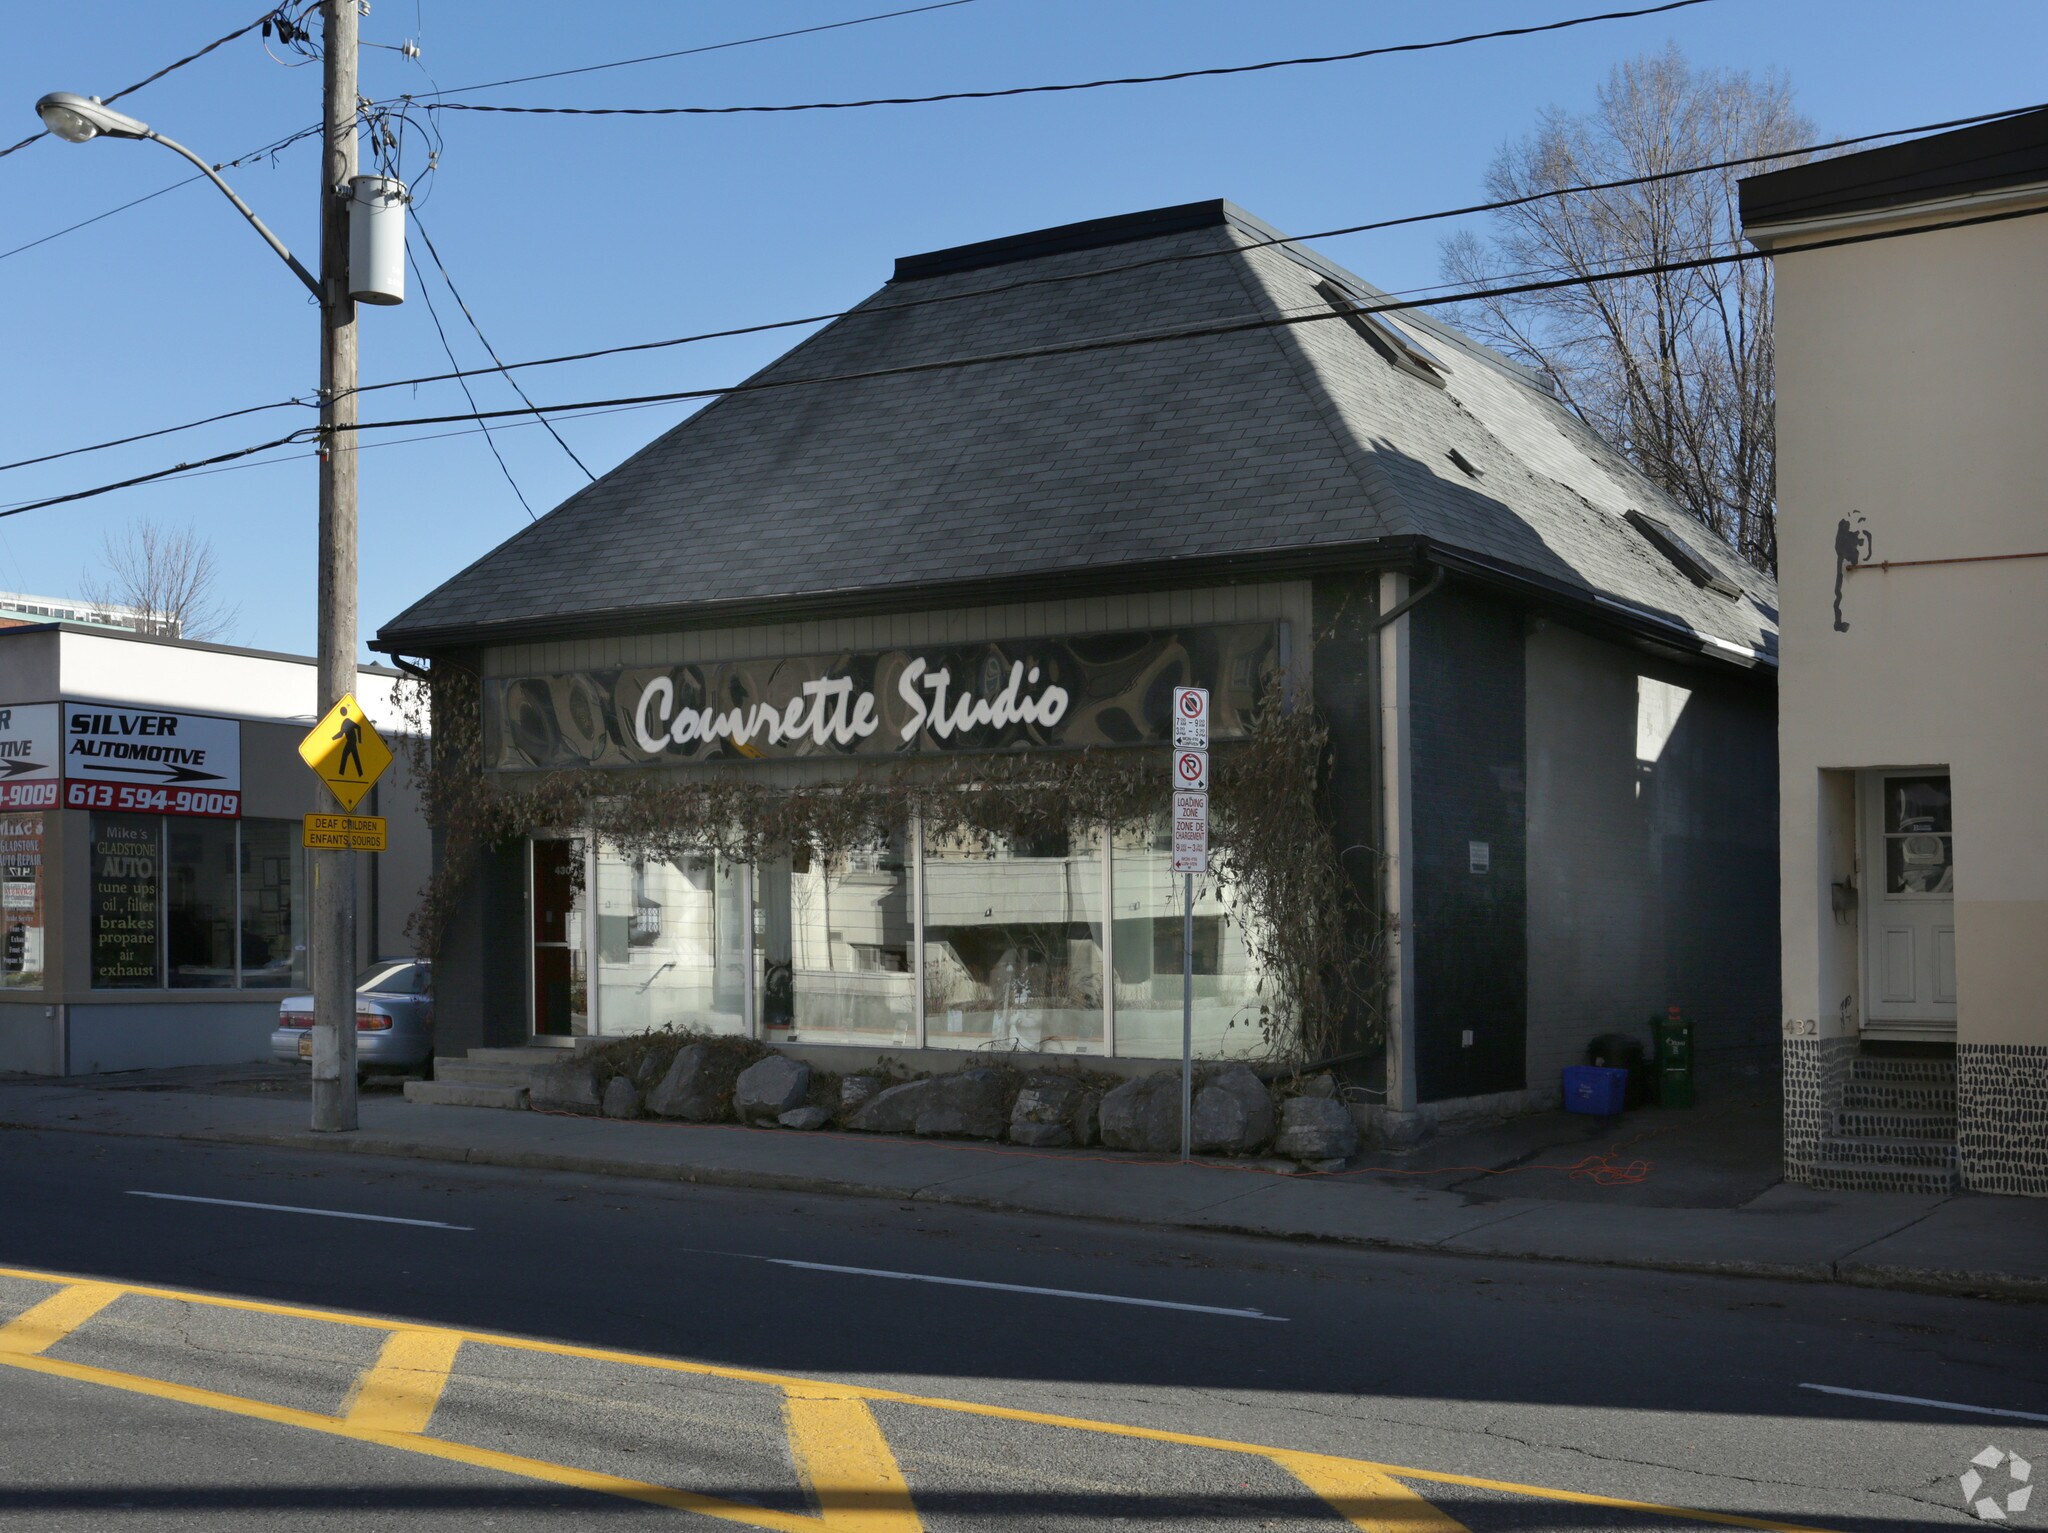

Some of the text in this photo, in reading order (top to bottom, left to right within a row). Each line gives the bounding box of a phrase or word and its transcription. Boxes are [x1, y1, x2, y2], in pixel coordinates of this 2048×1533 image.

[898, 657, 1069, 742] Studio
[70, 714, 178, 736] SILVER
[69, 738, 206, 765] AUTOMOTIVE
[68, 783, 238, 815] 613 594-9009
[1177, 797, 1204, 808] LOADING
[1182, 807, 1198, 817] ZONE
[315, 818, 377, 831] DEAF CHILDREN
[1176, 821, 1204, 831] ZONE DE
[106, 826, 148, 840] Mike's
[310, 833, 381, 847] ENFANTS SOURDS
[1175, 831, 1205, 841] CHARGEMENT
[0, 839, 39, 853] GLADSTONE
[97, 841, 156, 857] GLADSTONE
[102, 856, 152, 879] AUTO
[554, 866, 570, 875] 430
[98, 882, 155, 898] tune ups
[127, 896, 154, 912] filter
[100, 915, 154, 929] brakes
[99, 934, 154, 947] propane
[119, 949, 134, 961] air
[99, 962, 154, 976] exhaust
[1783, 1019, 1817, 1036] 432
